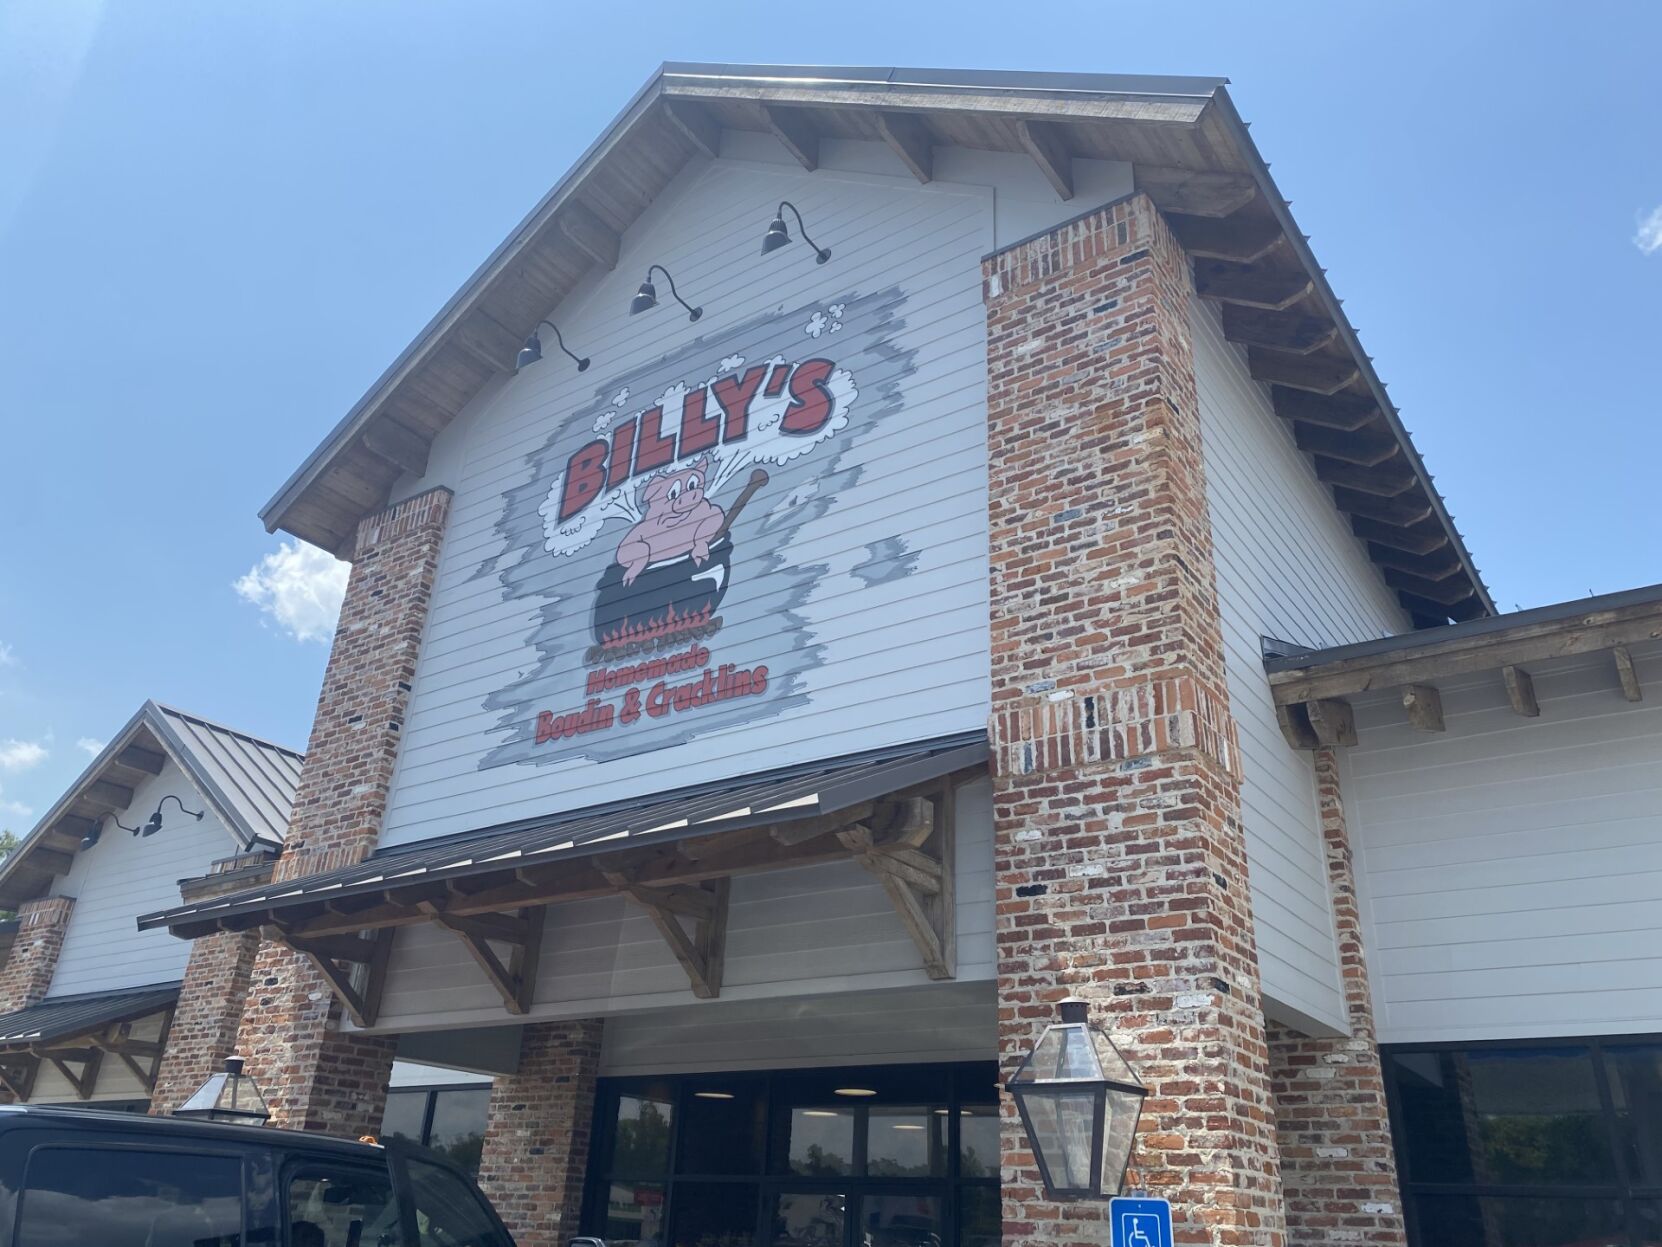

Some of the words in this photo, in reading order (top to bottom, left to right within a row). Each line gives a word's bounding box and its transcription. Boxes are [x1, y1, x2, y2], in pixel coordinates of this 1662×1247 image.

[558, 357, 835, 525] BILLY'S
[535, 699, 614, 745] Boudin
[620, 687, 642, 724] &
[646, 662, 769, 717] Cracklins
[586, 643, 709, 695] Homemade
